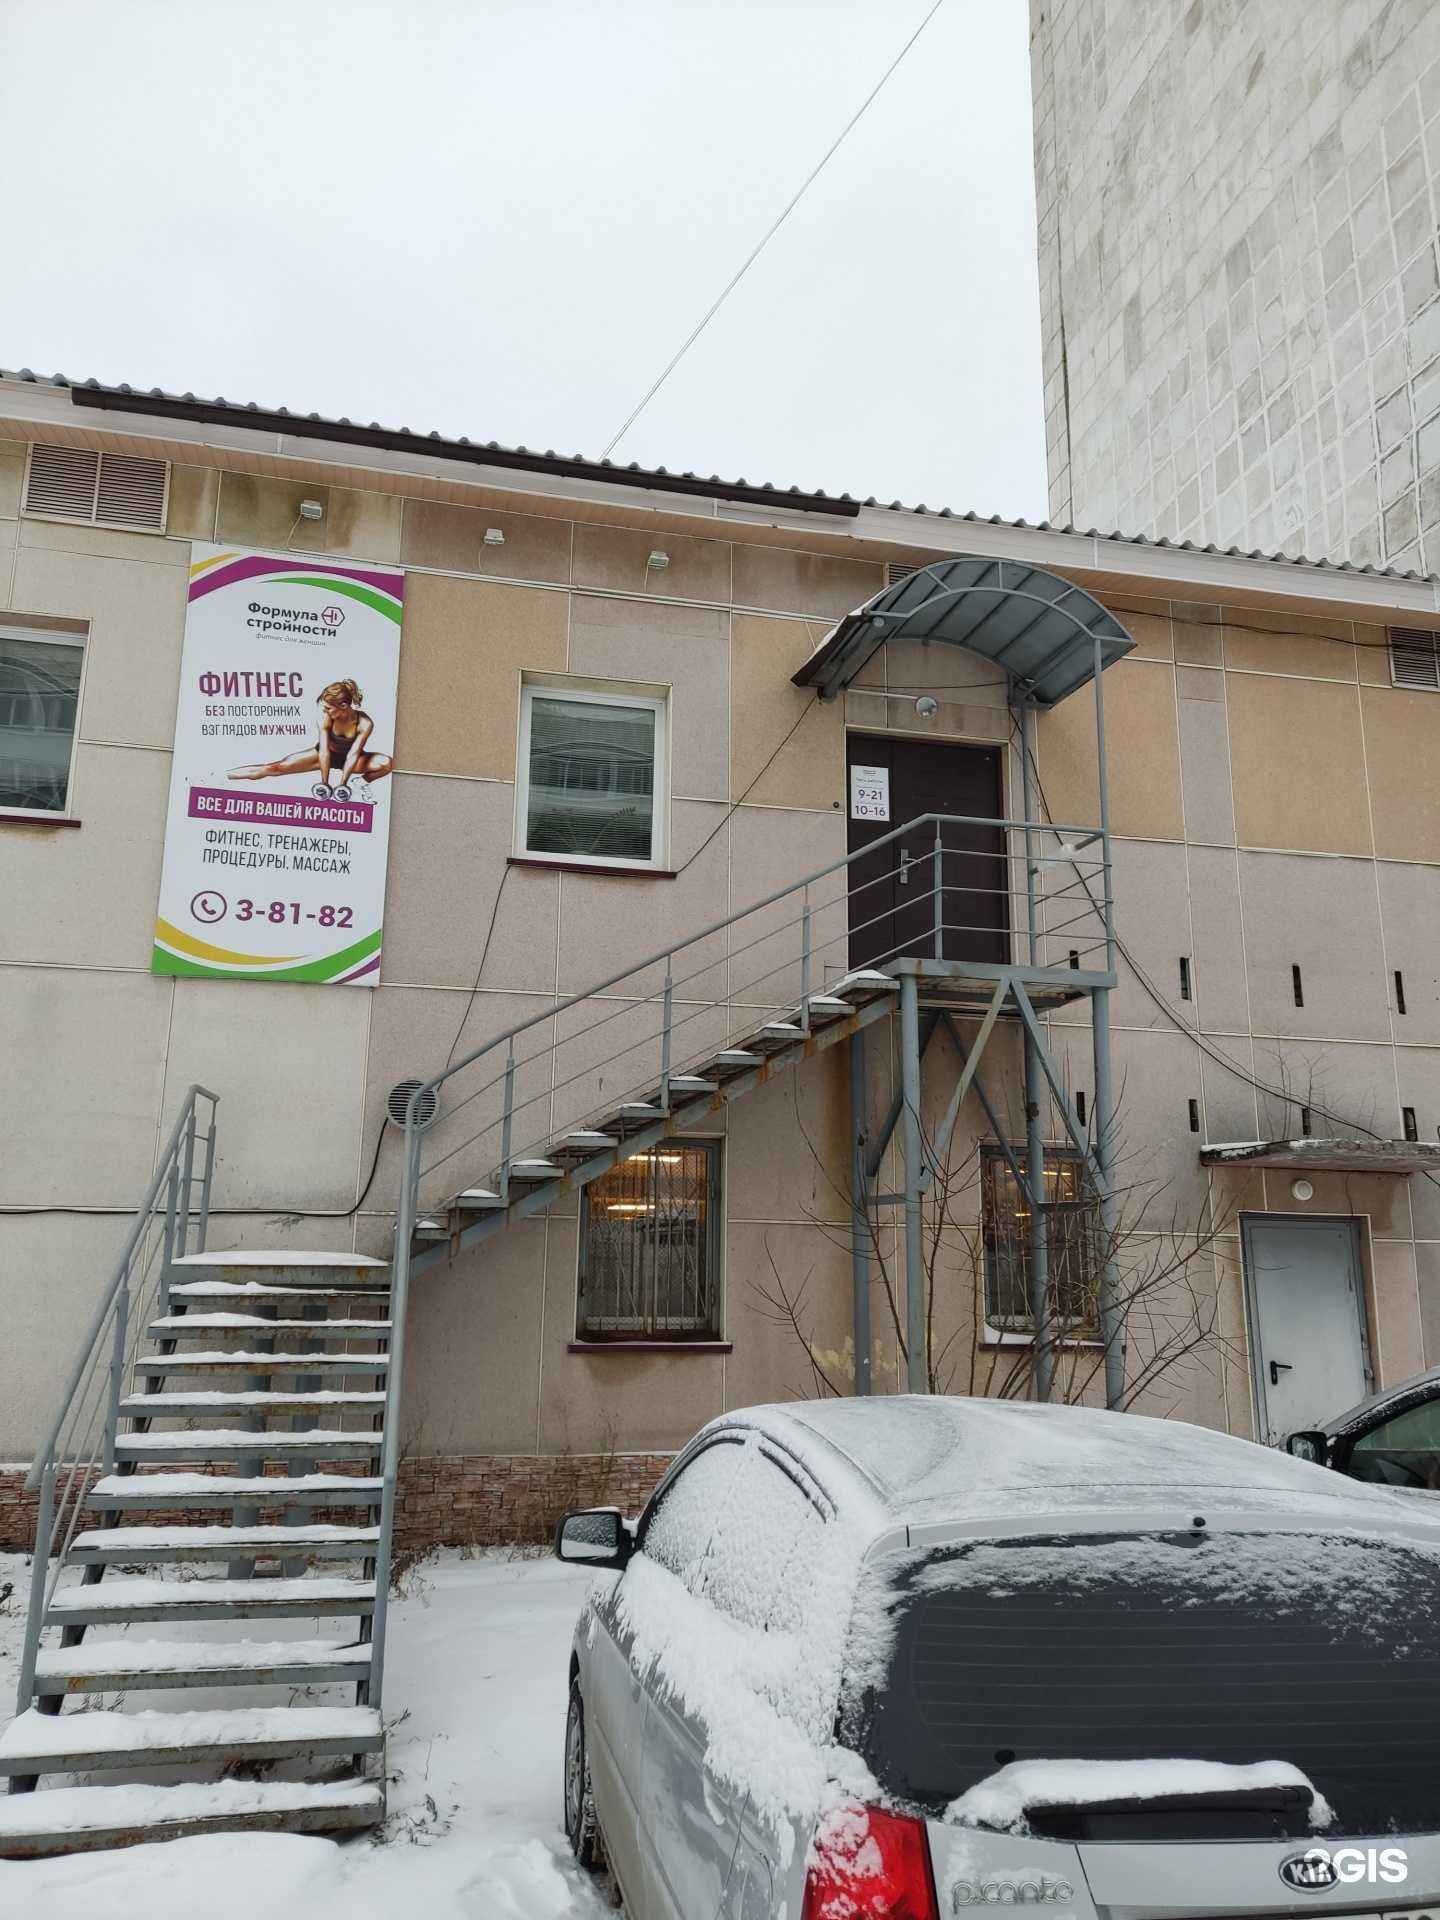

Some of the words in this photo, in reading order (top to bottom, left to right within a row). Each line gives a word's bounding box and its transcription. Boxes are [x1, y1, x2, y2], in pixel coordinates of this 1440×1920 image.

[248, 602, 318, 621] Формула
[247, 618, 337, 637] стройности
[199, 671, 303, 698] ФИТНЕС
[205, 705, 225, 717] БЕЗ
[227, 705, 301, 717] ПОСТОРОННИХ
[201, 724, 257, 736] ВЗГЛЯДОВ
[259, 724, 306, 736] МУЖЧИН
[858, 789, 882, 800] 9-21
[197, 796, 222, 812] ВСЕ
[224, 799, 254, 815] ДЛЯ
[255, 802, 302, 819] ВАШЕЙ
[304, 806, 364, 825] КРАСОТЫ
[855, 805, 886, 817] 10-16
[205, 829, 263, 849] ФИТНЕС,
[268, 834, 351, 856] ТРЕНАЖЕРЫ,
[292, 856, 351, 874] МАССАЖ
[235, 898, 354, 929] 3-81-82
